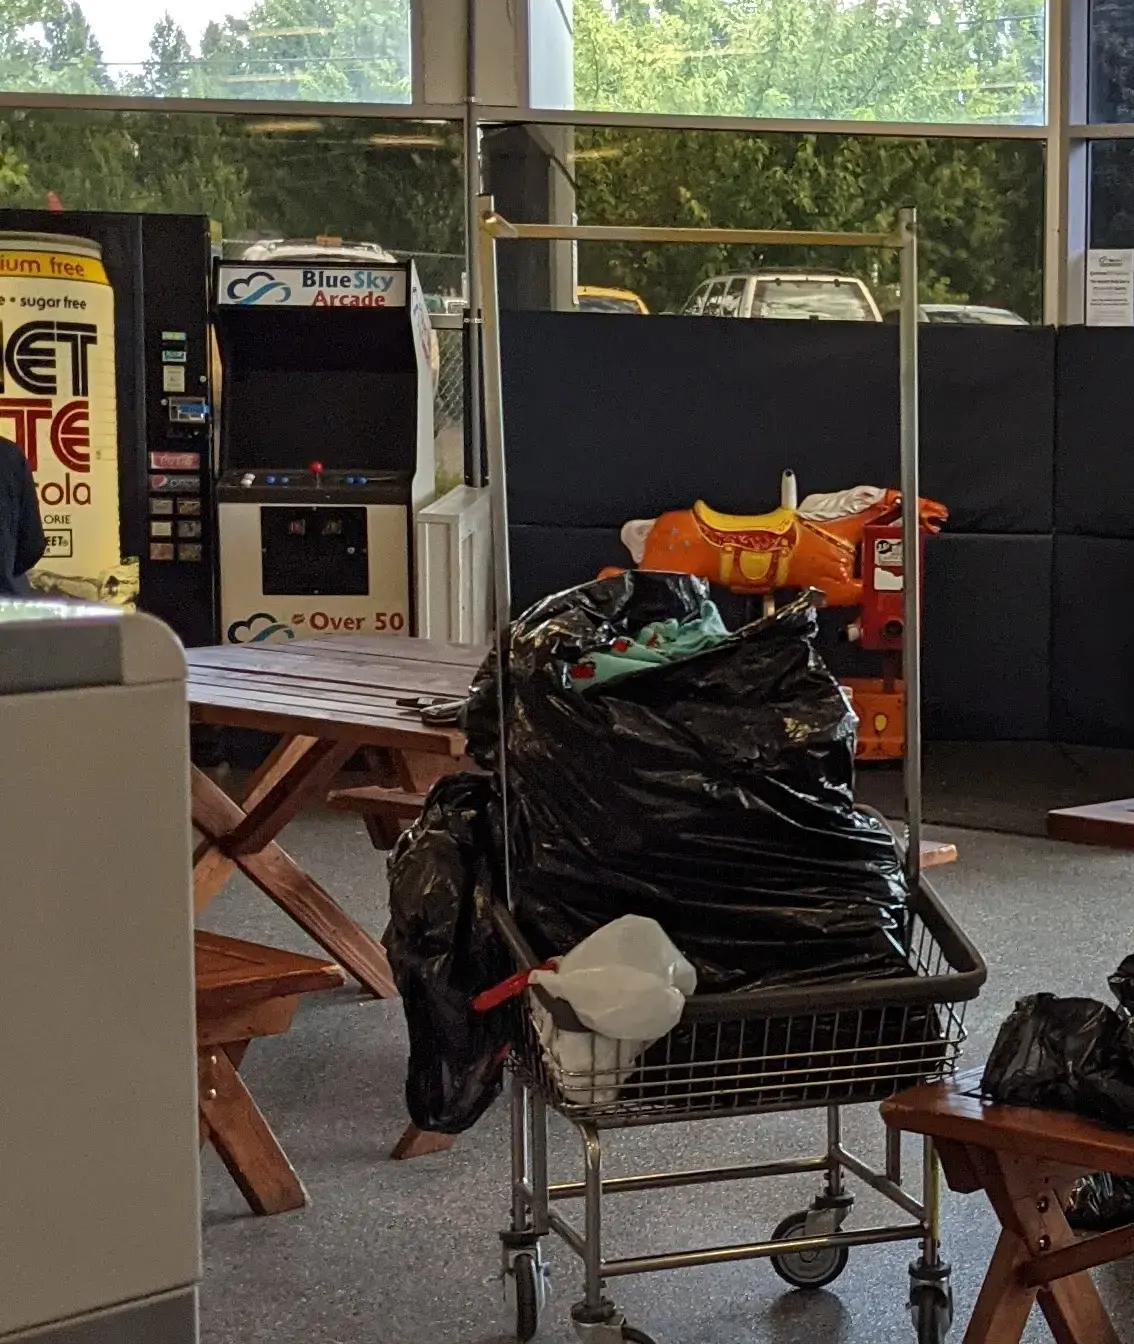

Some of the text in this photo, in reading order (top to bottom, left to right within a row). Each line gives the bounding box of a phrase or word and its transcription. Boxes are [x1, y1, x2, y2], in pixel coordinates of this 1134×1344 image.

[49, 257, 84, 276] free
[20, 297, 61, 311] sugar
[64, 295, 87, 310] free
[312, 290, 386, 307] Arcade
[0, 320, 98, 398] ET
[34, 472, 92, 506] ola
[42, 514, 72, 525] ORIE
[309, 611, 404, 631] Over 50
